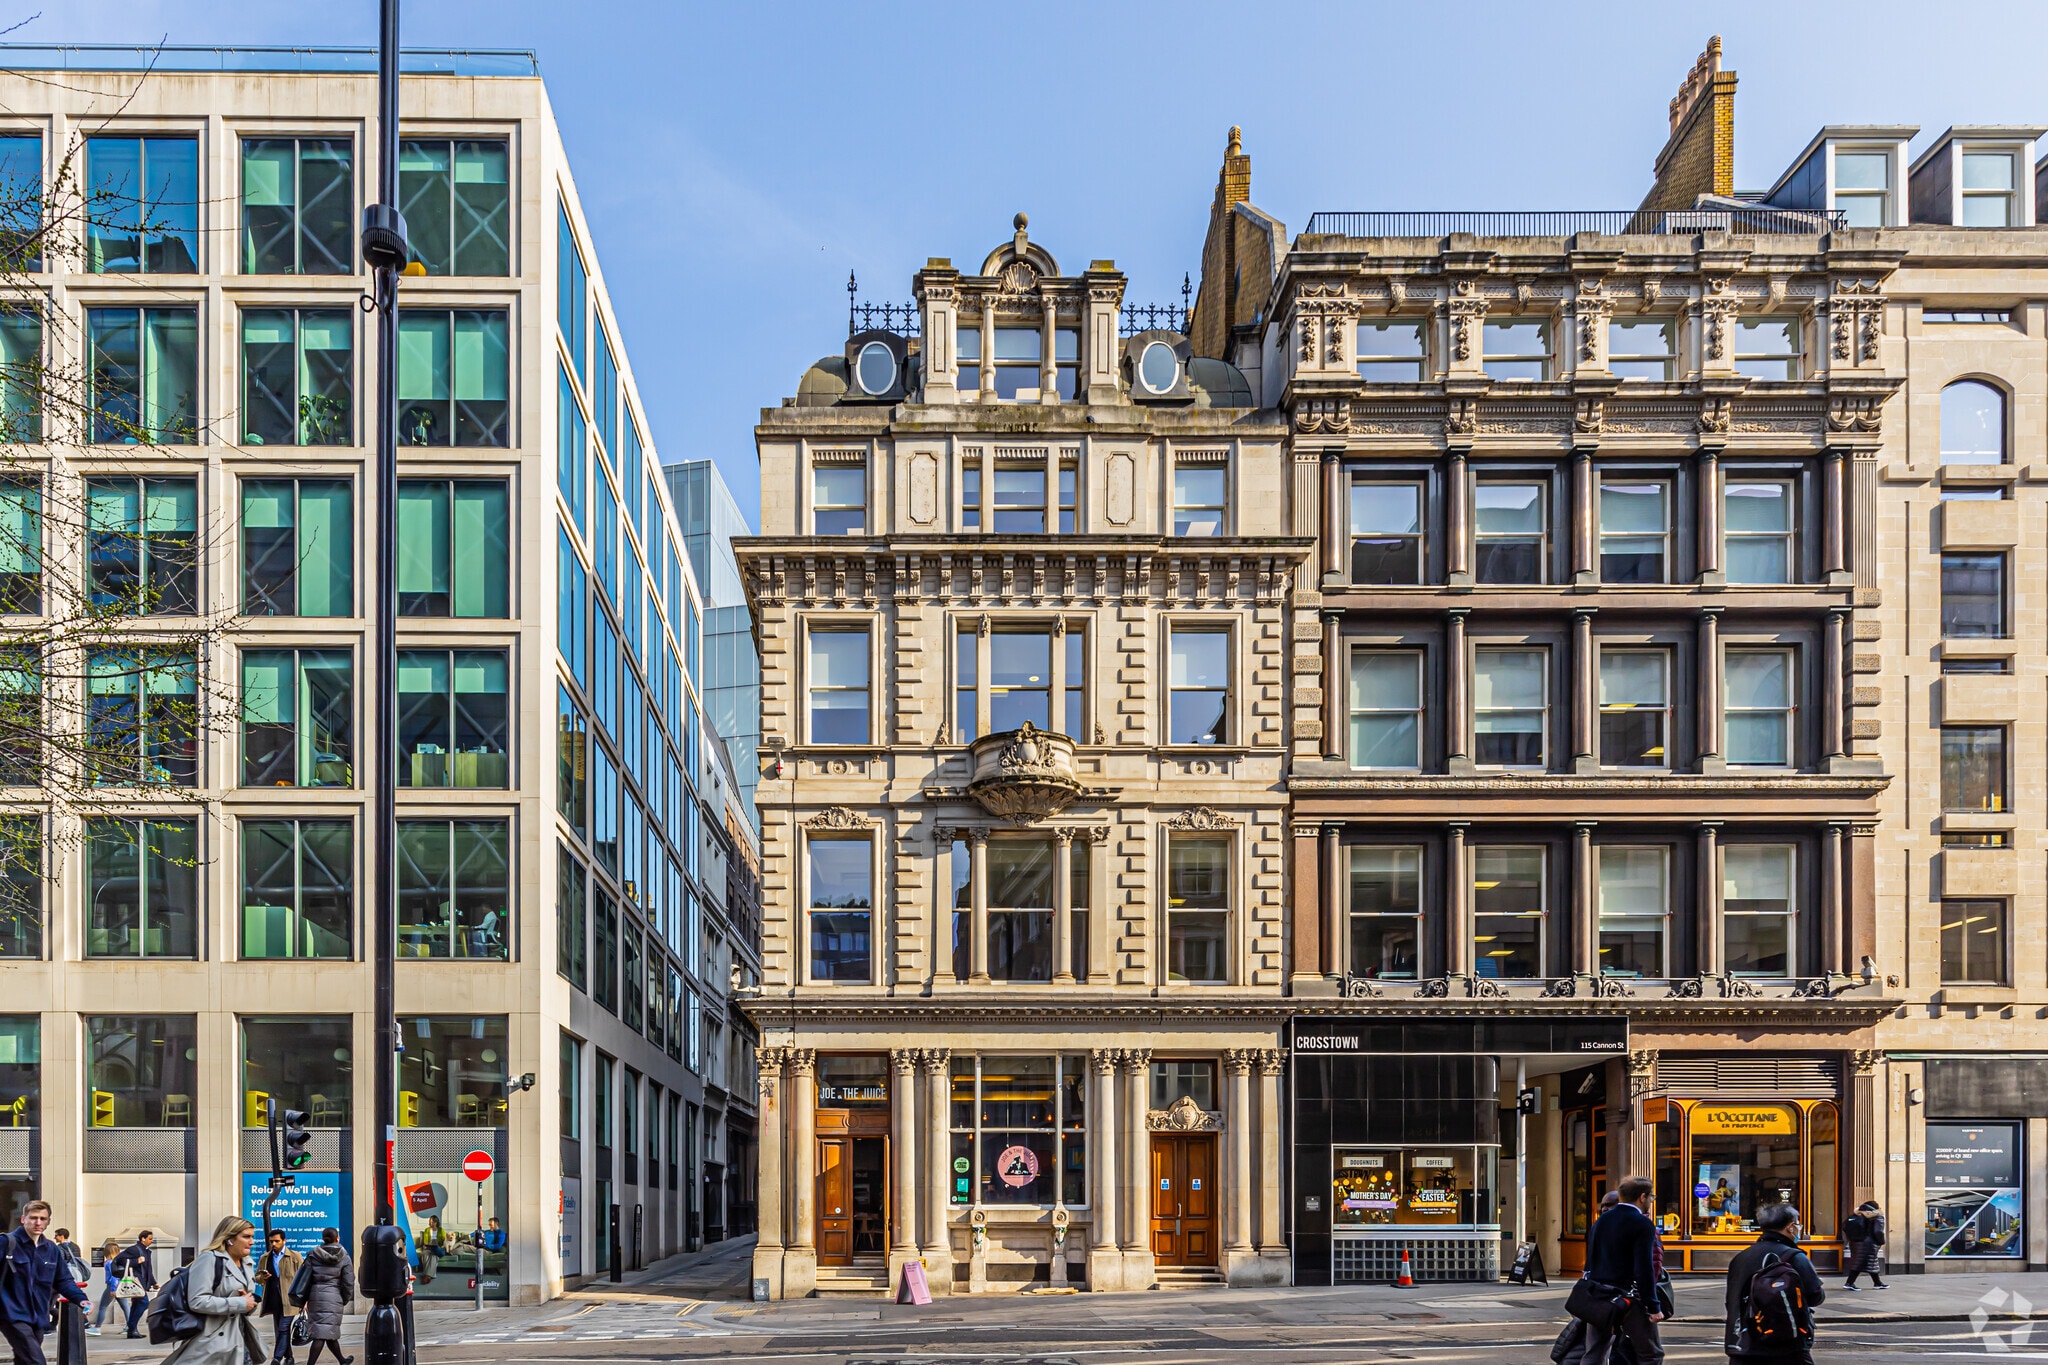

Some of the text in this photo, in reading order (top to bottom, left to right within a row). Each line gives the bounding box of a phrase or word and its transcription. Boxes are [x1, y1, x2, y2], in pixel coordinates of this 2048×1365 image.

[1296, 1036, 1359, 1049] CROSSTOWN
[1592, 1041, 1617, 1049] Cannon
[1617, 1041, 1625, 1049] St
[819, 1087, 836, 1099] JOE
[842, 1087, 859, 1099] THE
[861, 1087, 887, 1099] JUICE
[1707, 1111, 1779, 1123] L'OCCITANE
[251, 1185, 334, 1196] Rela. We'll help
[1350, 1191, 1393, 1200] MOTHER'S DAY
[1422, 1193, 1445, 1202] EASTER
[291, 1199, 313, 1208] your
[251, 1209, 328, 1218] ta allowances.
[482, 1280, 500, 1288] idelity
